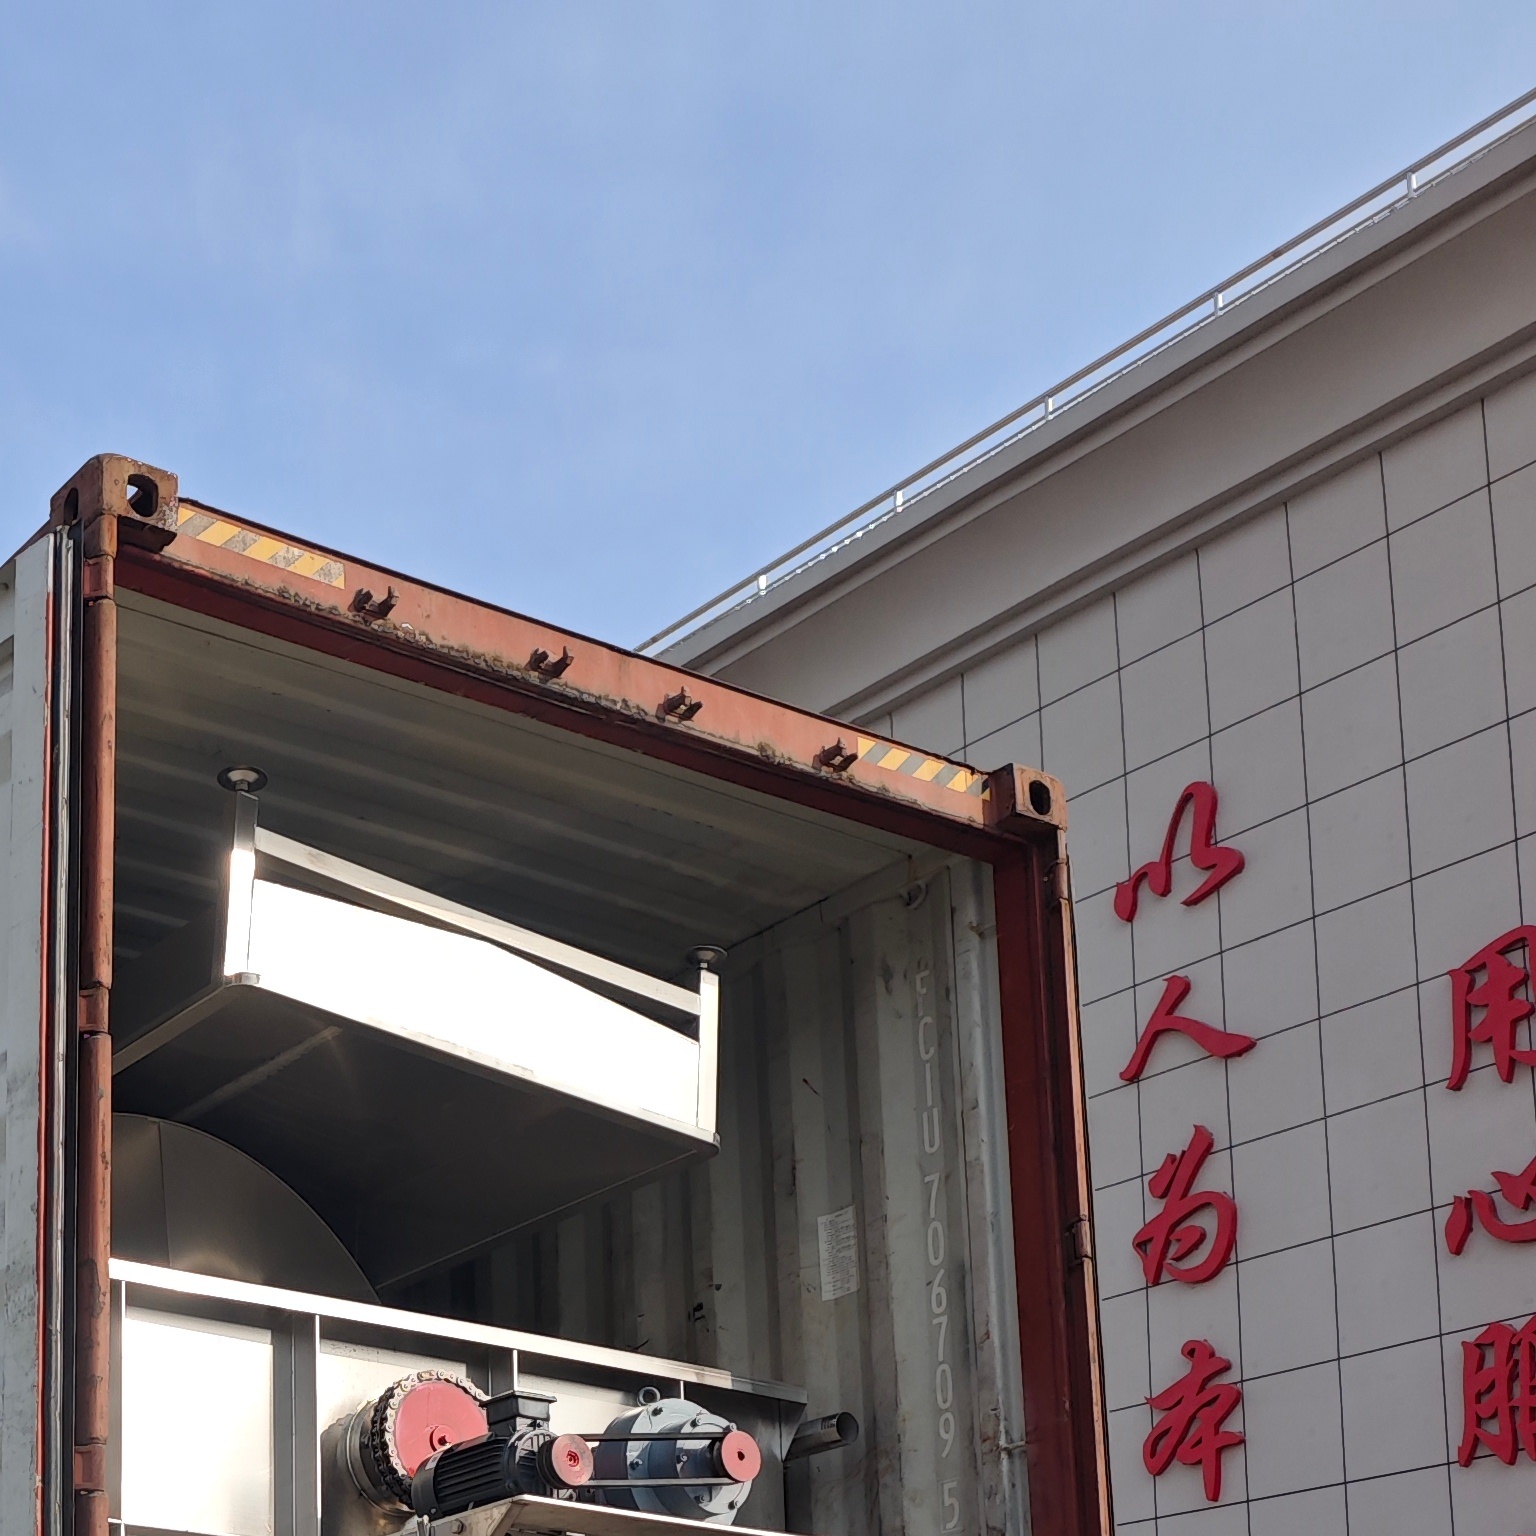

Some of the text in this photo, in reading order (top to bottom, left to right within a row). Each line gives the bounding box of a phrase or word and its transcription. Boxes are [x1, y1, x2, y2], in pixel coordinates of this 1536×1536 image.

[924, 1173, 955, 1458] 706709
[942, 1480, 960, 1530] 5
[1114, 781, 1257, 1502] 以人为本
